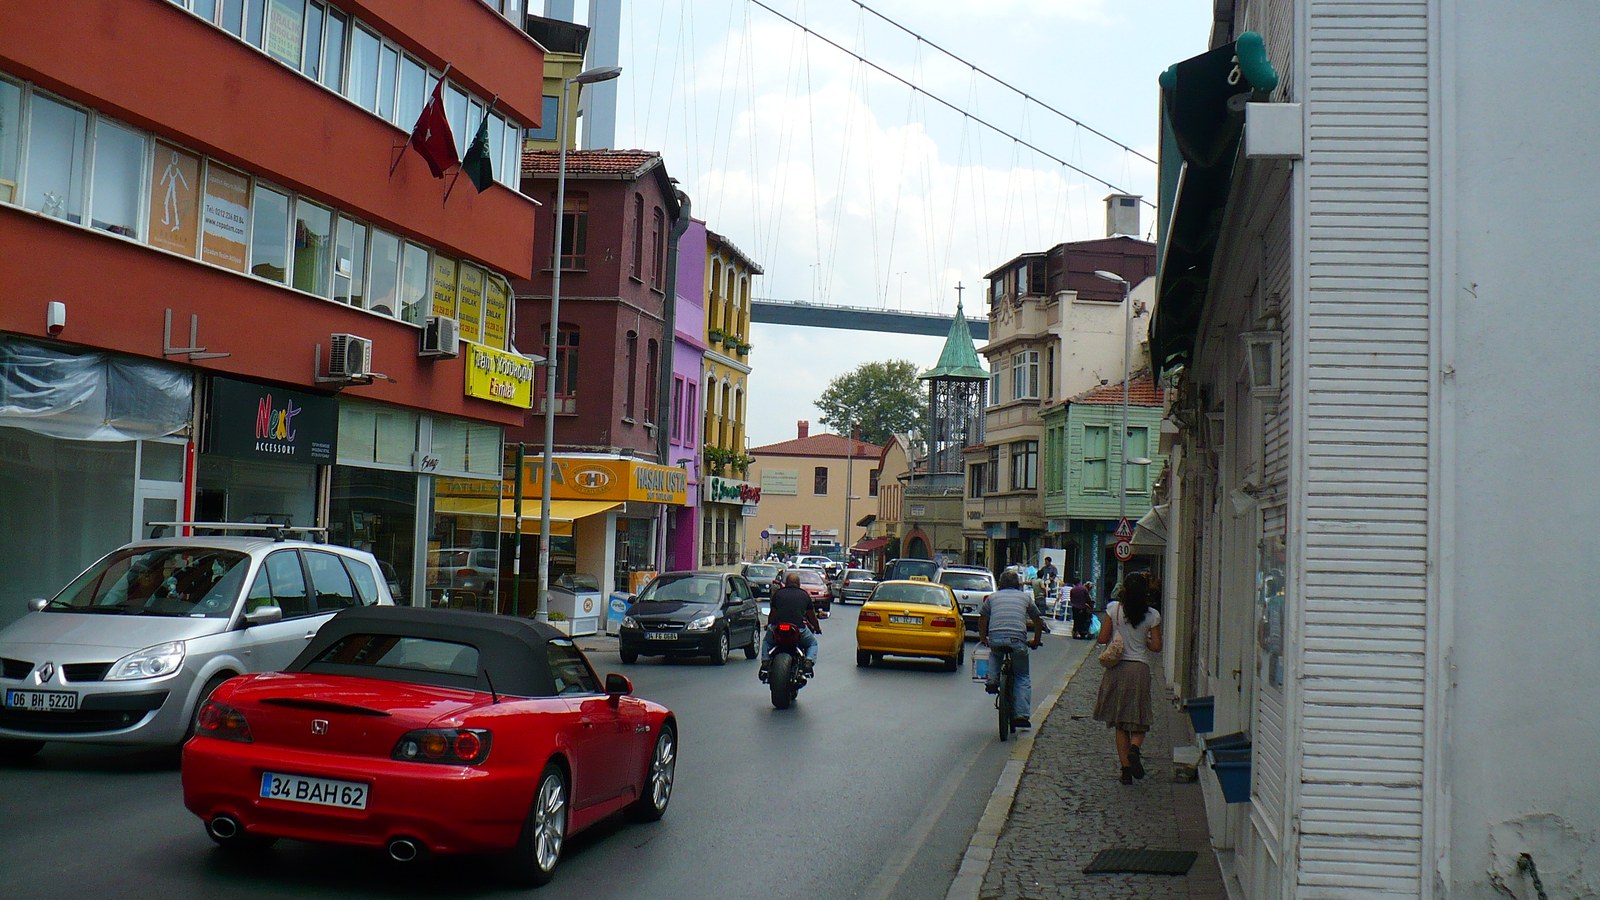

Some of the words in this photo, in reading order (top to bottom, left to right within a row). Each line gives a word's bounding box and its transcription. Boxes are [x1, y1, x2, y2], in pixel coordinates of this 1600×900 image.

[434, 291, 451, 303] EMLAK
[462, 296, 477, 307] EMLAK
[486, 308, 501, 320] EMLAK
[489, 377, 515, 399] Emlak
[255, 393, 302, 441] Next
[255, 441, 296, 455] ACCESSORY
[636, 466, 665, 492] HASAN
[665, 471, 687, 494] USTA
[1118, 545, 1129, 555] 30
[13, 693, 25, 705] 06
[32, 693, 44, 706] BH
[49, 694, 74, 708] 5220
[271, 778, 290, 798] 34
[295, 780, 338, 803] BAH
[341, 786, 363, 806] 62
